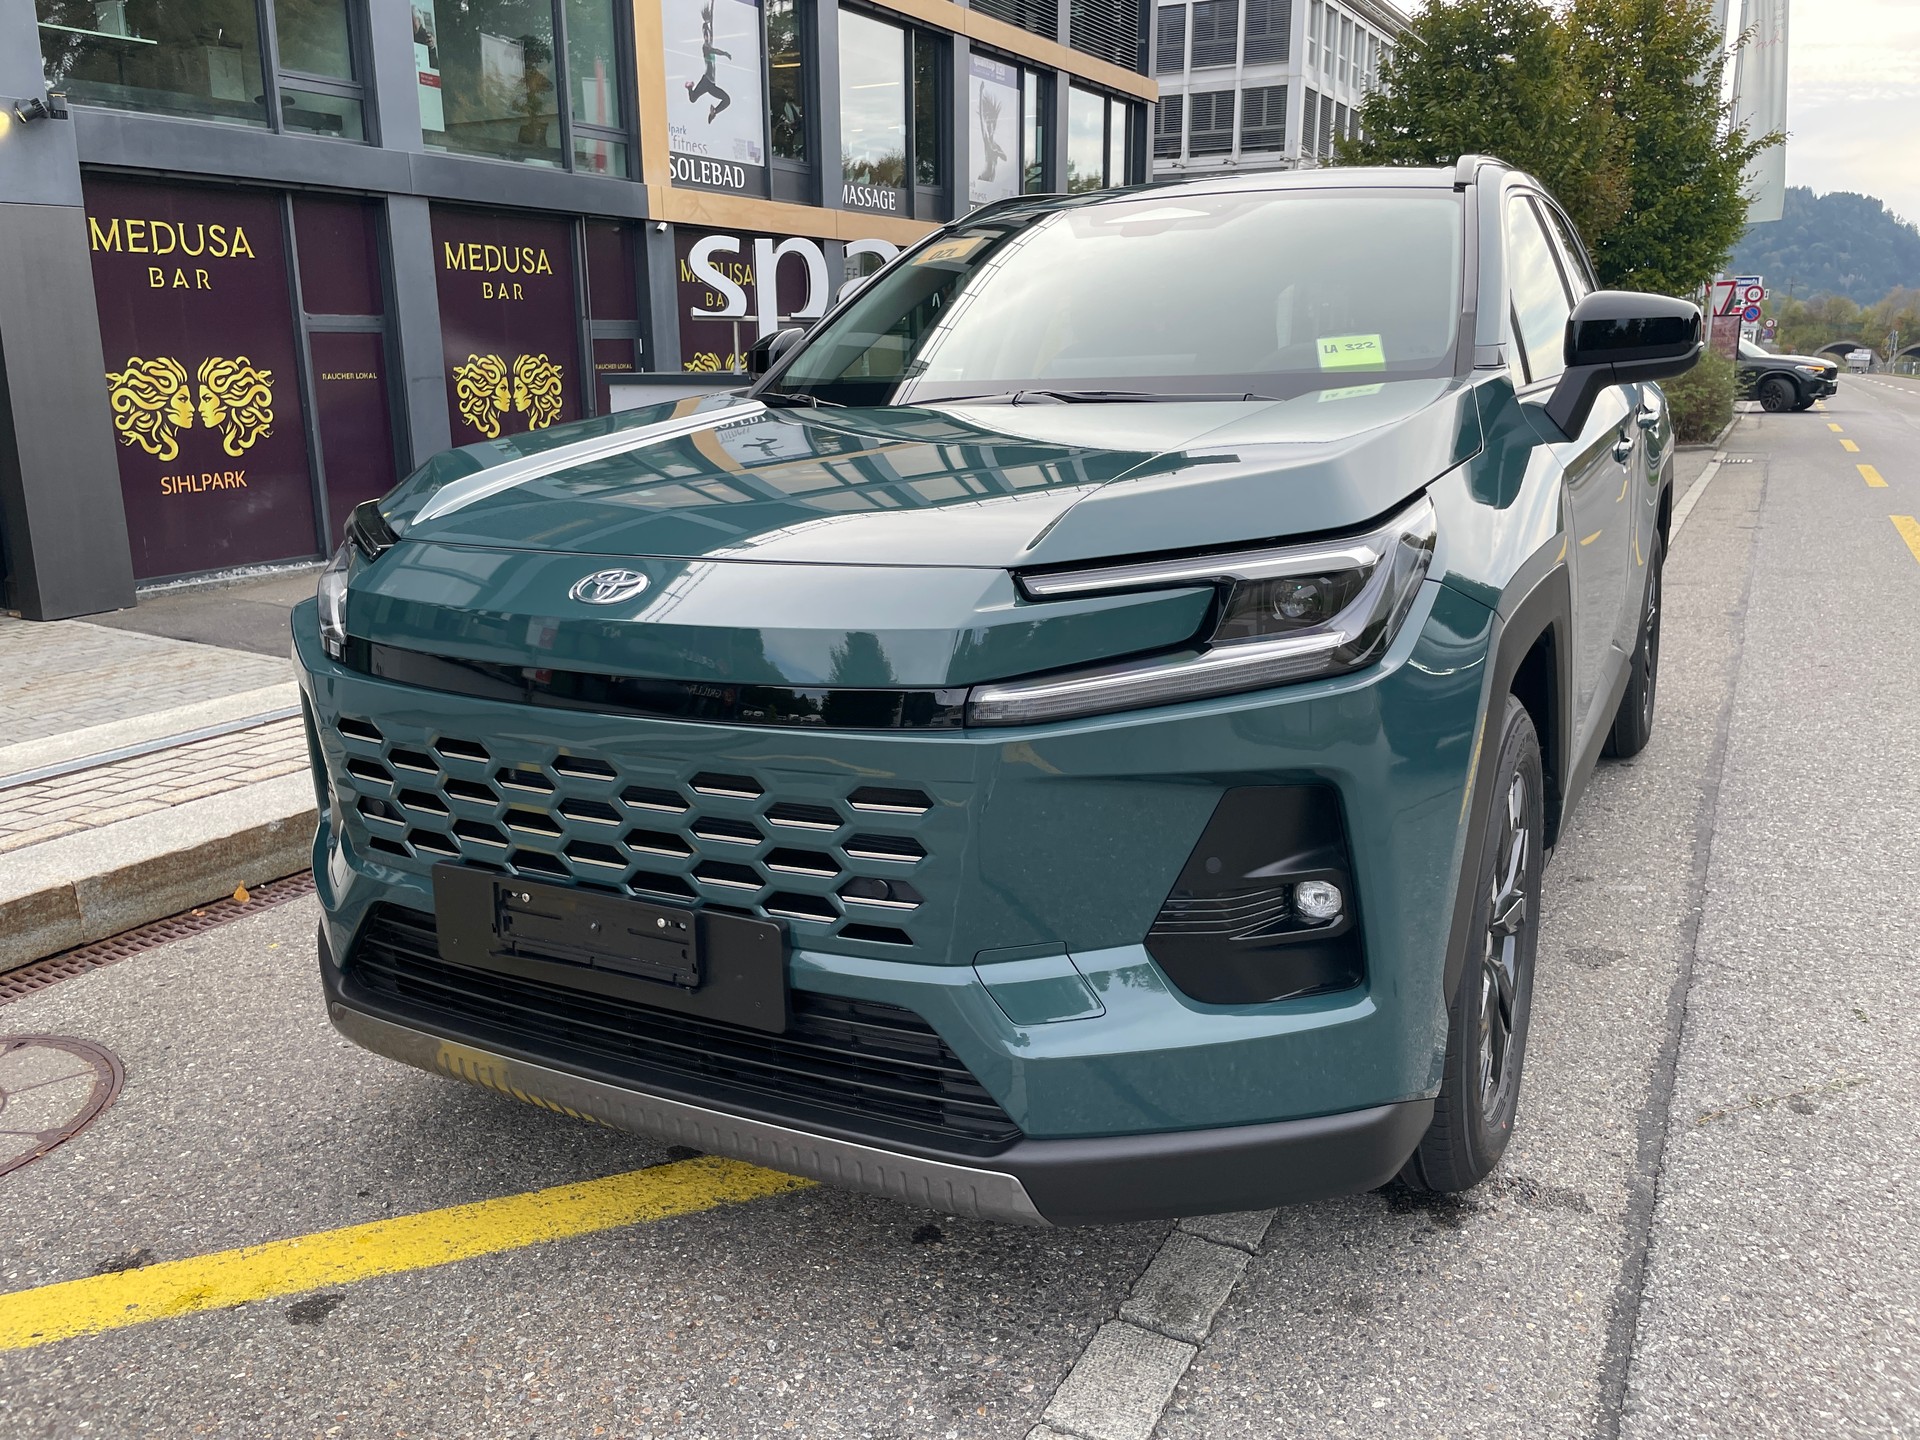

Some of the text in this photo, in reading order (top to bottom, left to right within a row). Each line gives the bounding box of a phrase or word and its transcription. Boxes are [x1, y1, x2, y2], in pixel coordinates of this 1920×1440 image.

[672, 135, 708, 155] fitness
[669, 155, 745, 189] SOLEBAD
[89, 217, 256, 260] MEDUSA
[444, 241, 553, 276] MEDUSA
[149, 267, 212, 290] BAR
[482, 281, 525, 301] BAR
[705, 292, 726, 307] BA
[1749, 290, 1759, 298] 60
[1324, 341, 1376, 354] LA 322
[322, 372, 378, 381] RAUCHER LOKAL
[160, 470, 248, 496] SIHLPARK
